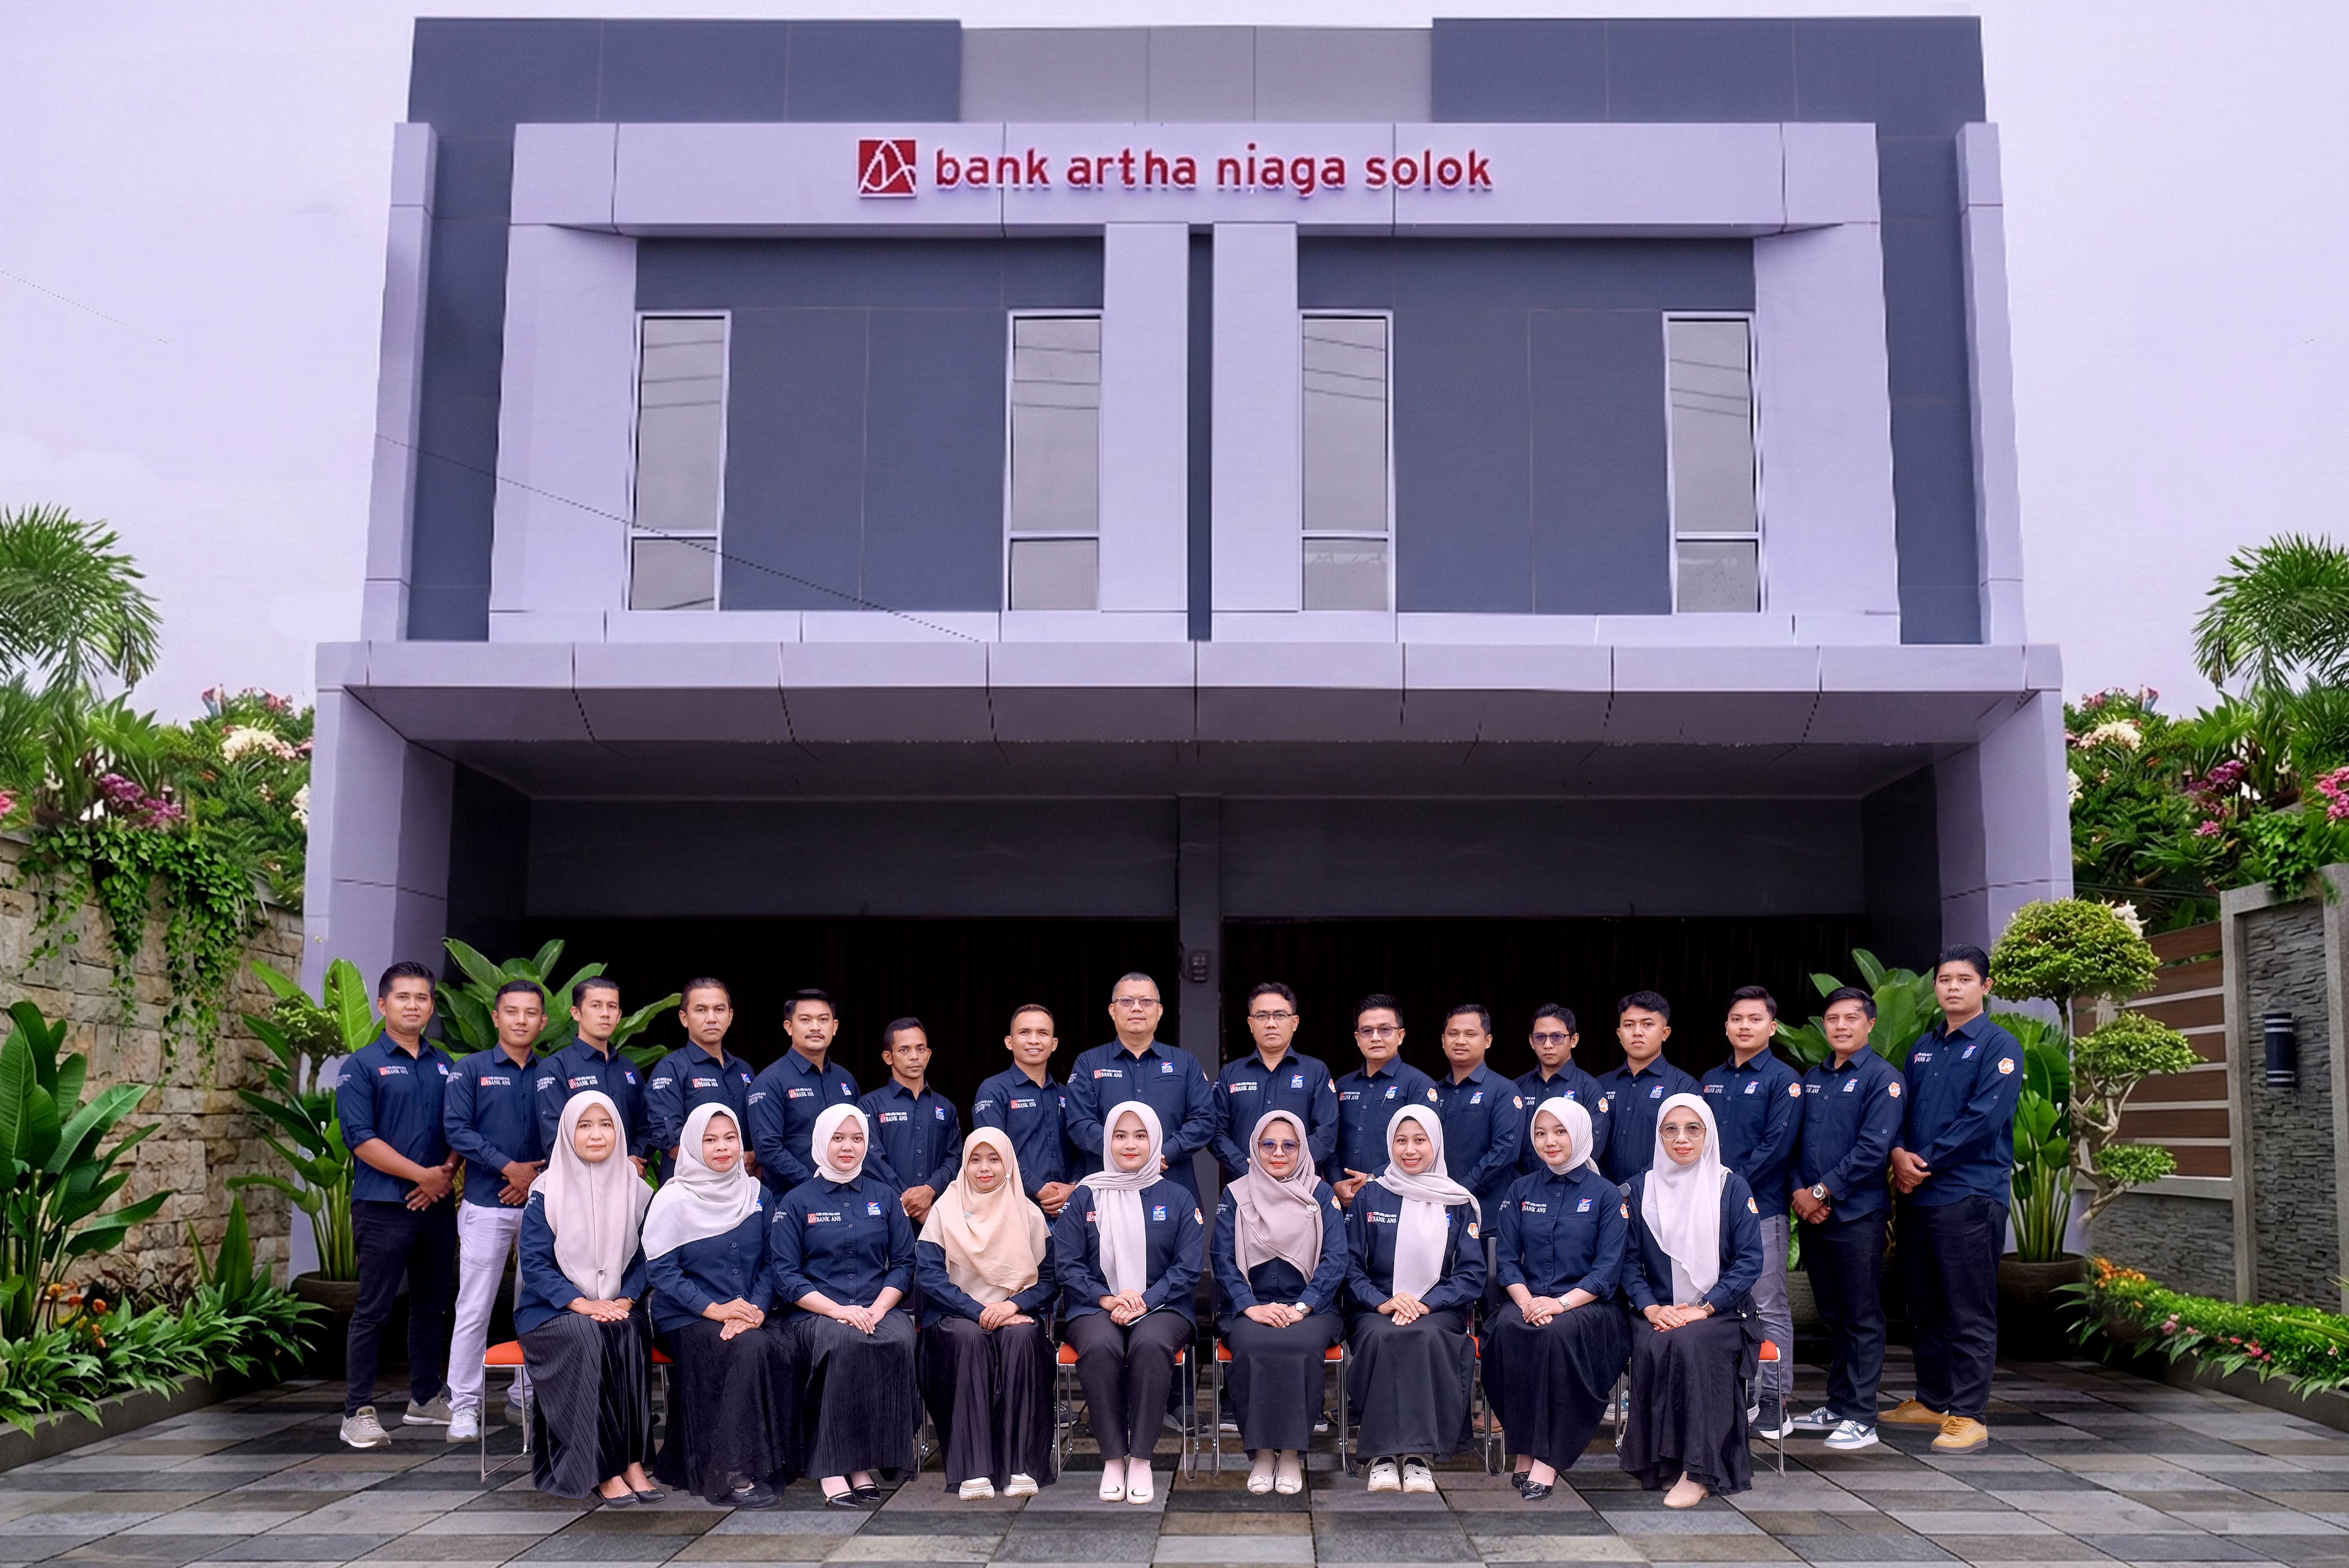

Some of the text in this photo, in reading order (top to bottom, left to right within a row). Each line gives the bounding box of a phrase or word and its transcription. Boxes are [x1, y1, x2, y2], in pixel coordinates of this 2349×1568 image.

[936, 142, 1492, 197] bank artha niaga solok
[576, 1080, 589, 1088] BANK
[588, 1077, 598, 1085] ANS
